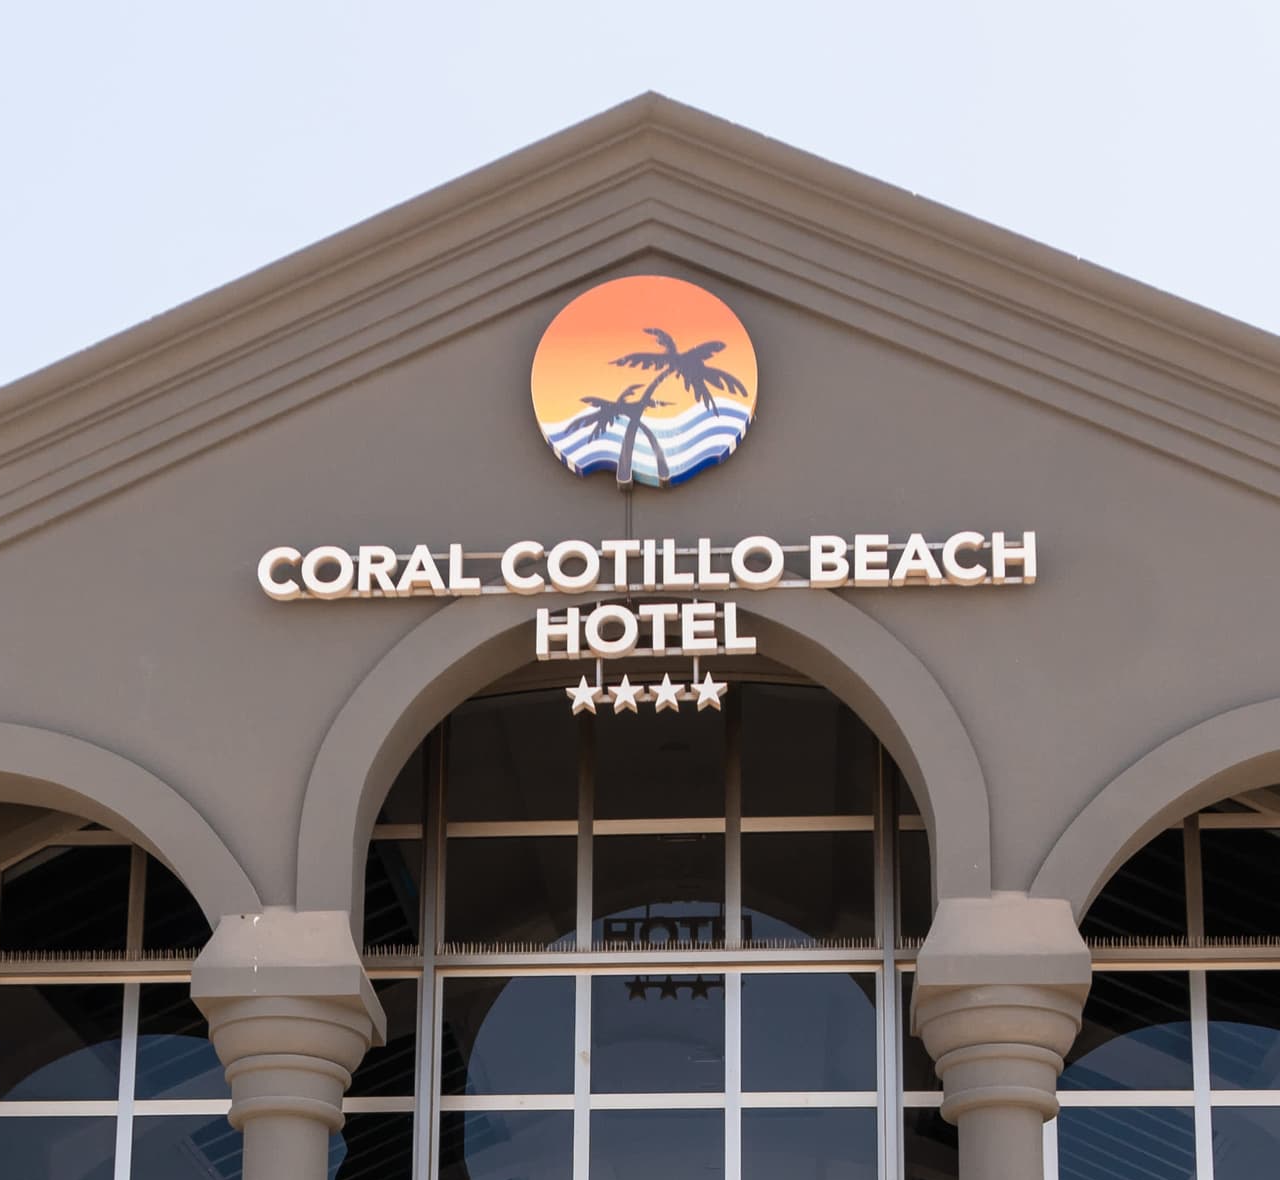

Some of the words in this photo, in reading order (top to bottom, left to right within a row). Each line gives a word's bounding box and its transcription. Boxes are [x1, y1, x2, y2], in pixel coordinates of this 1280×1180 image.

[256, 543, 481, 600] CORAL
[500, 535, 785, 591] COTILLO
[809, 530, 1039, 587] BEACH
[534, 601, 757, 659] HOTEL
